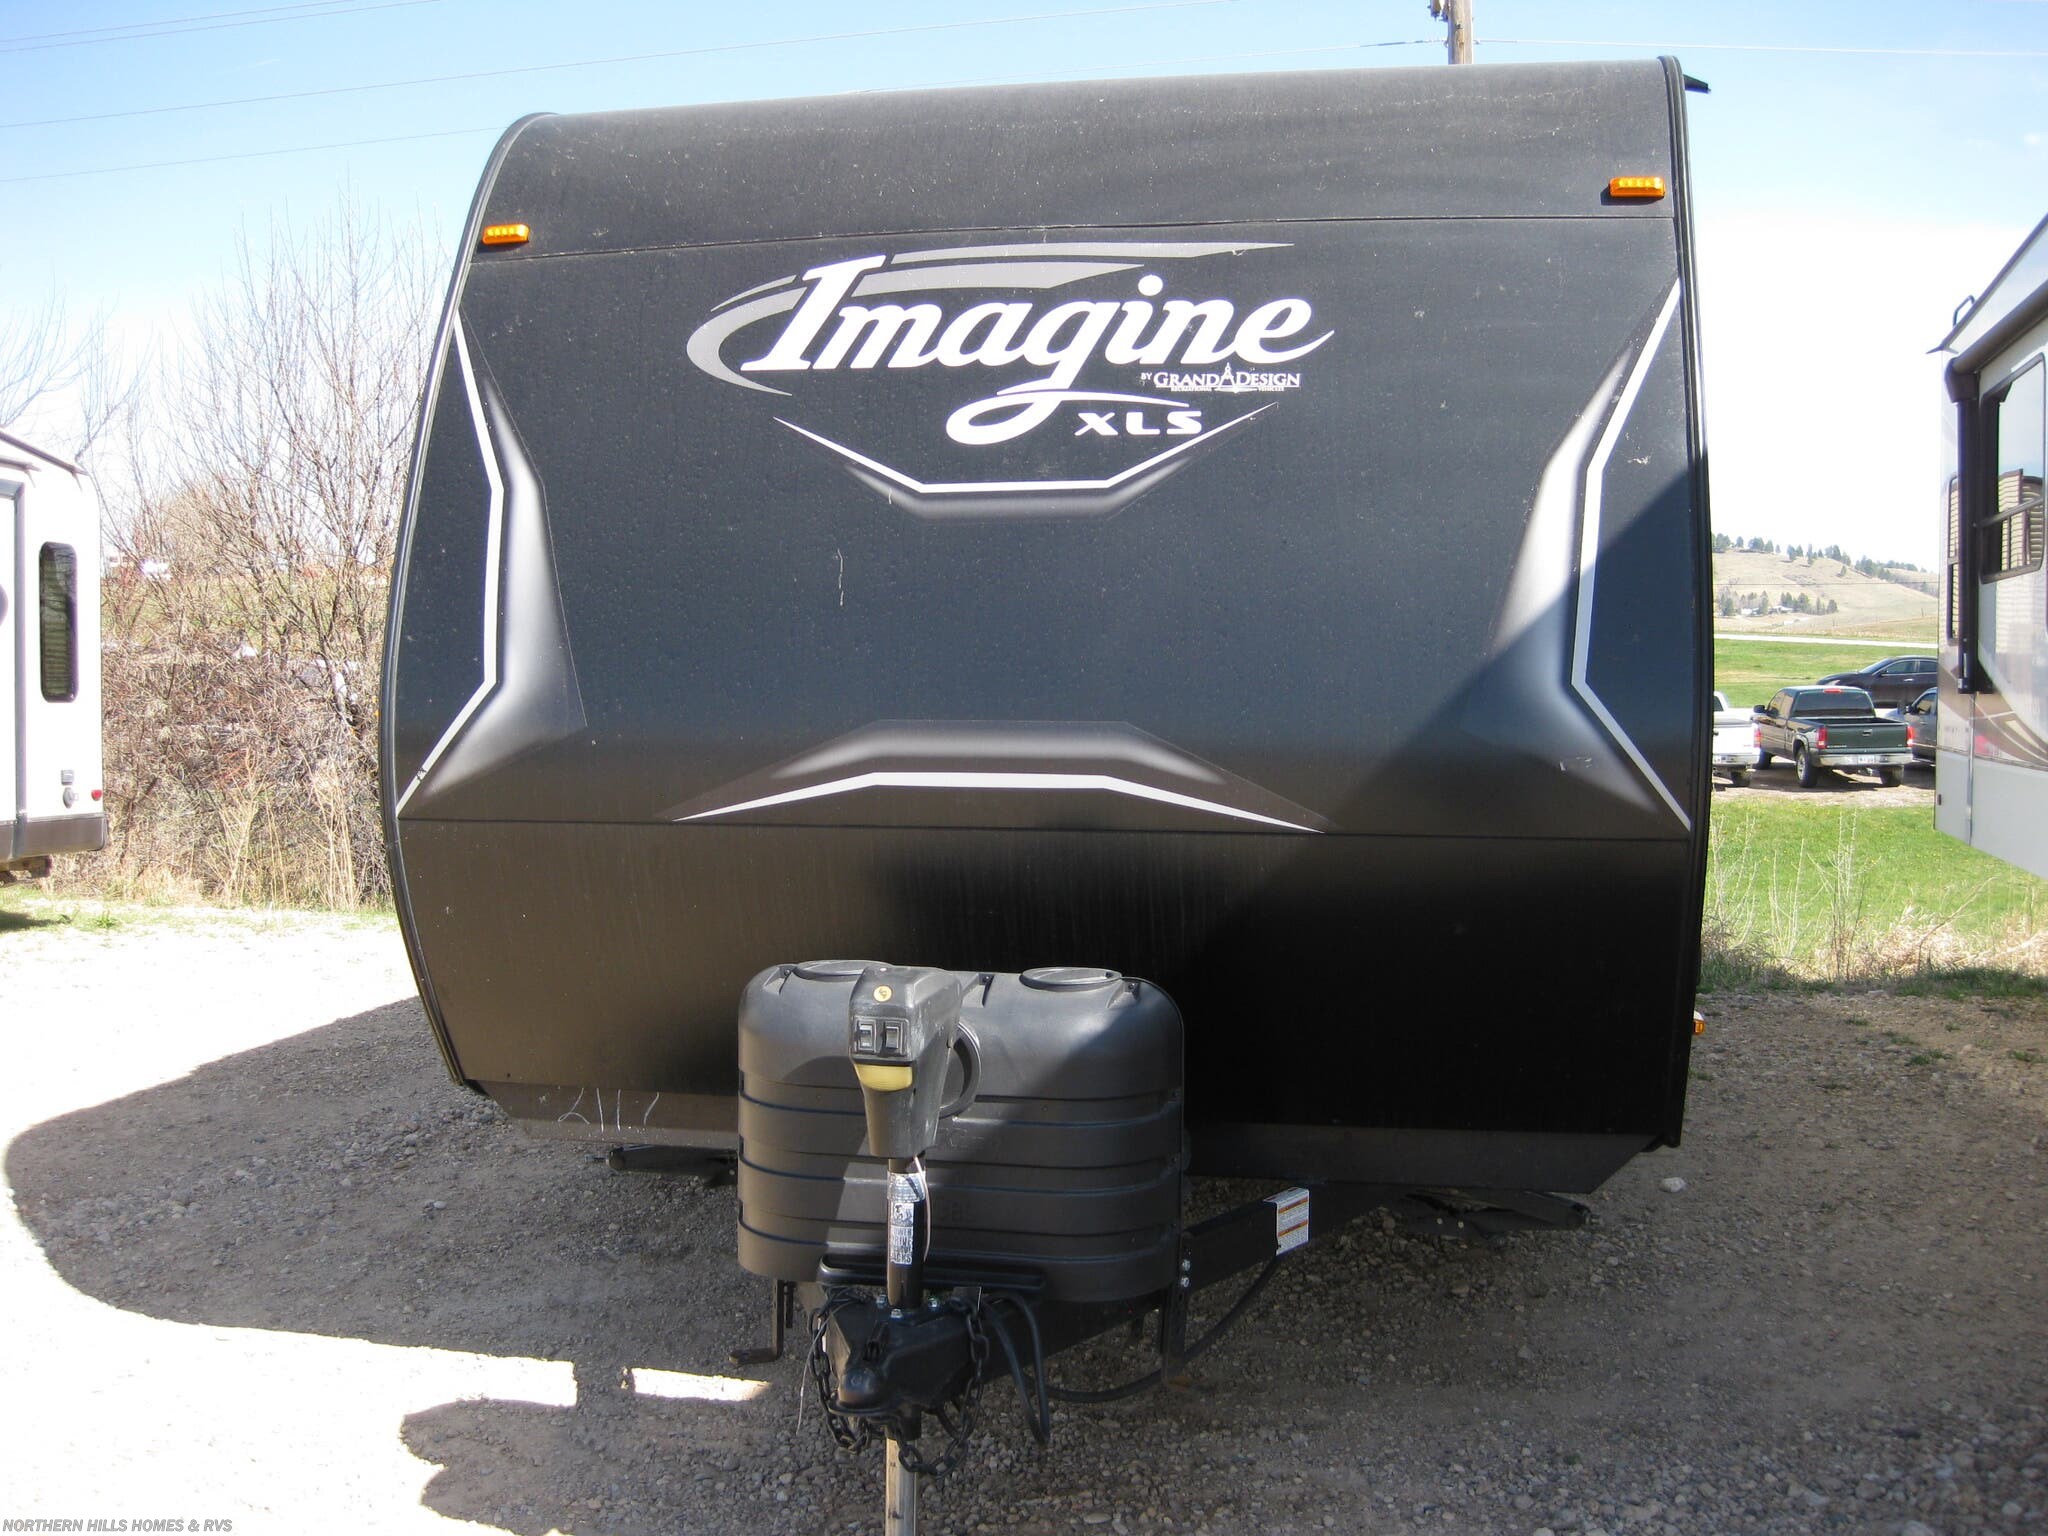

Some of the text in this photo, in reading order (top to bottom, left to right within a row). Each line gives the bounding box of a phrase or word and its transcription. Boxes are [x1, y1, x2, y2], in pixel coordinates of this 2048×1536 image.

[741, 255, 1334, 445] Imagine
[1153, 372, 1220, 386] GRAND
[1236, 371, 1301, 387] DESIGN
[1074, 411, 1202, 436] XLS
